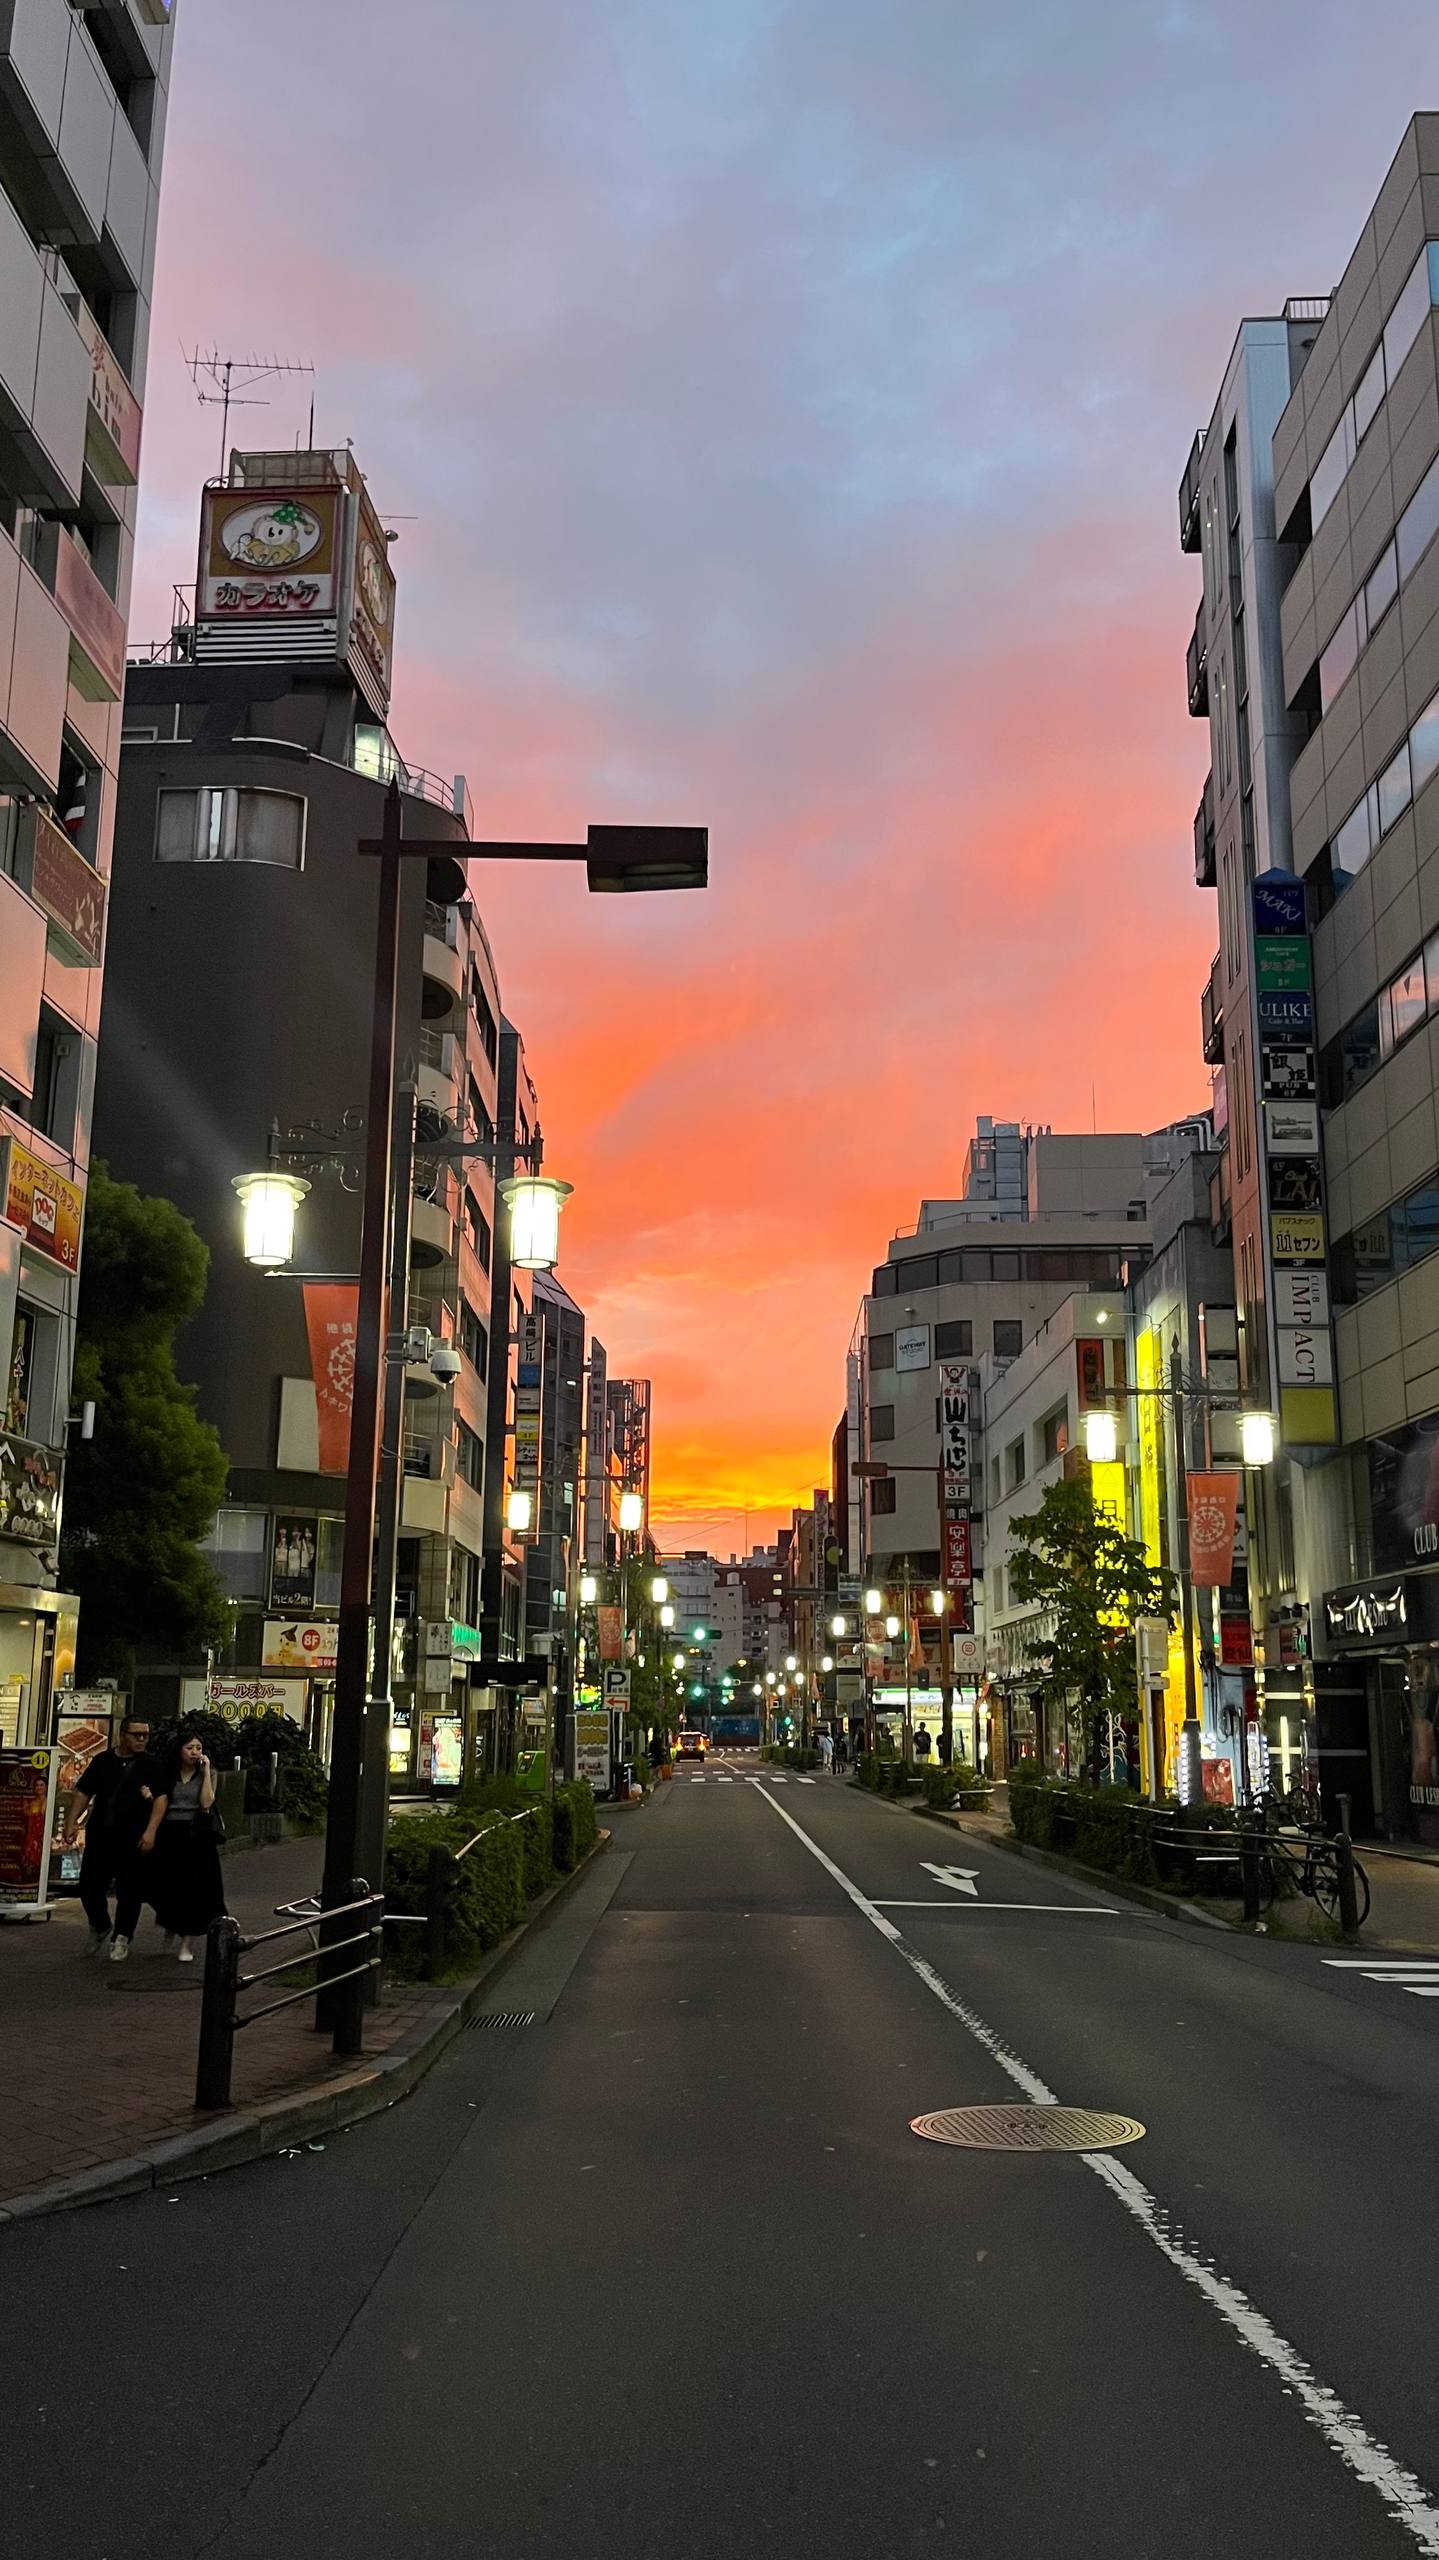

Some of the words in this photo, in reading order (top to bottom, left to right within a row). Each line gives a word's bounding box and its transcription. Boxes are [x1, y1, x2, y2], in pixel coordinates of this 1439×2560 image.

[215, 580, 319, 608] カラオケ
[1256, 889, 1302, 920] MAKI
[1260, 1002, 1313, 1017] ULIKE
[62, 1240, 75, 1262] 3F
[1311, 1275, 1321, 1303] CLUB
[1291, 1276, 1316, 1383] IMPACT
[898, 1341, 926, 1351] GATEWAY
[947, 1486, 966, 1497] 3F
[1414, 1522, 1438, 1556] CLUB
[304, 1634, 319, 1646] 8F
[607, 1671, 626, 1693] P
